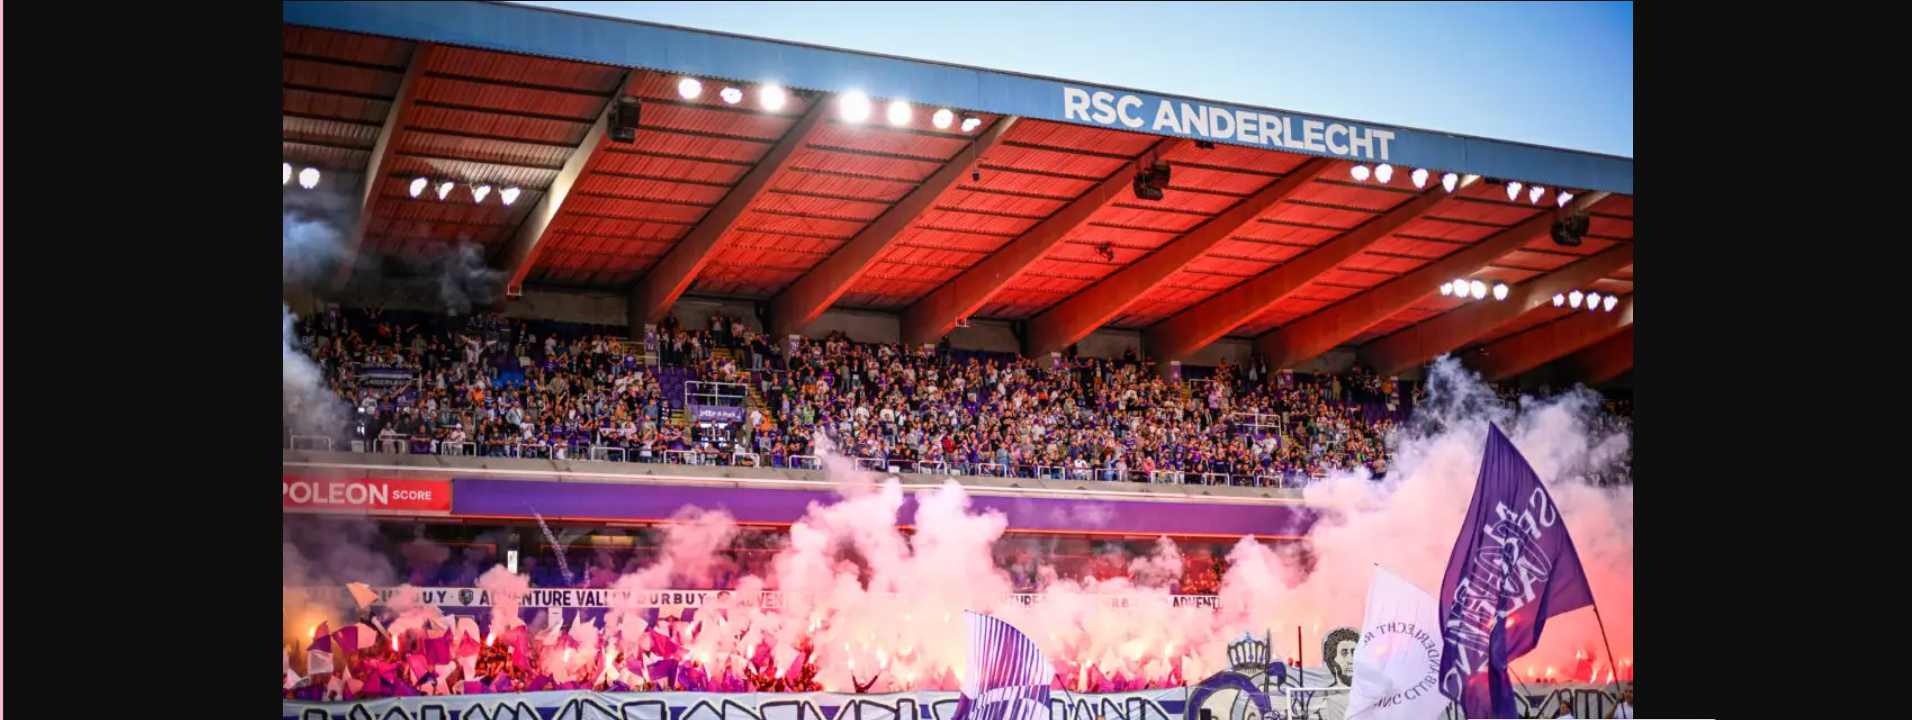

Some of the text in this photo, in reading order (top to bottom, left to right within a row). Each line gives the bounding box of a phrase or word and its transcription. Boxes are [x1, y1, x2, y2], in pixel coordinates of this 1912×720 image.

[1063, 86, 1396, 162] RSC ANDERLECHT
[391, 489, 432, 501] SCORE
